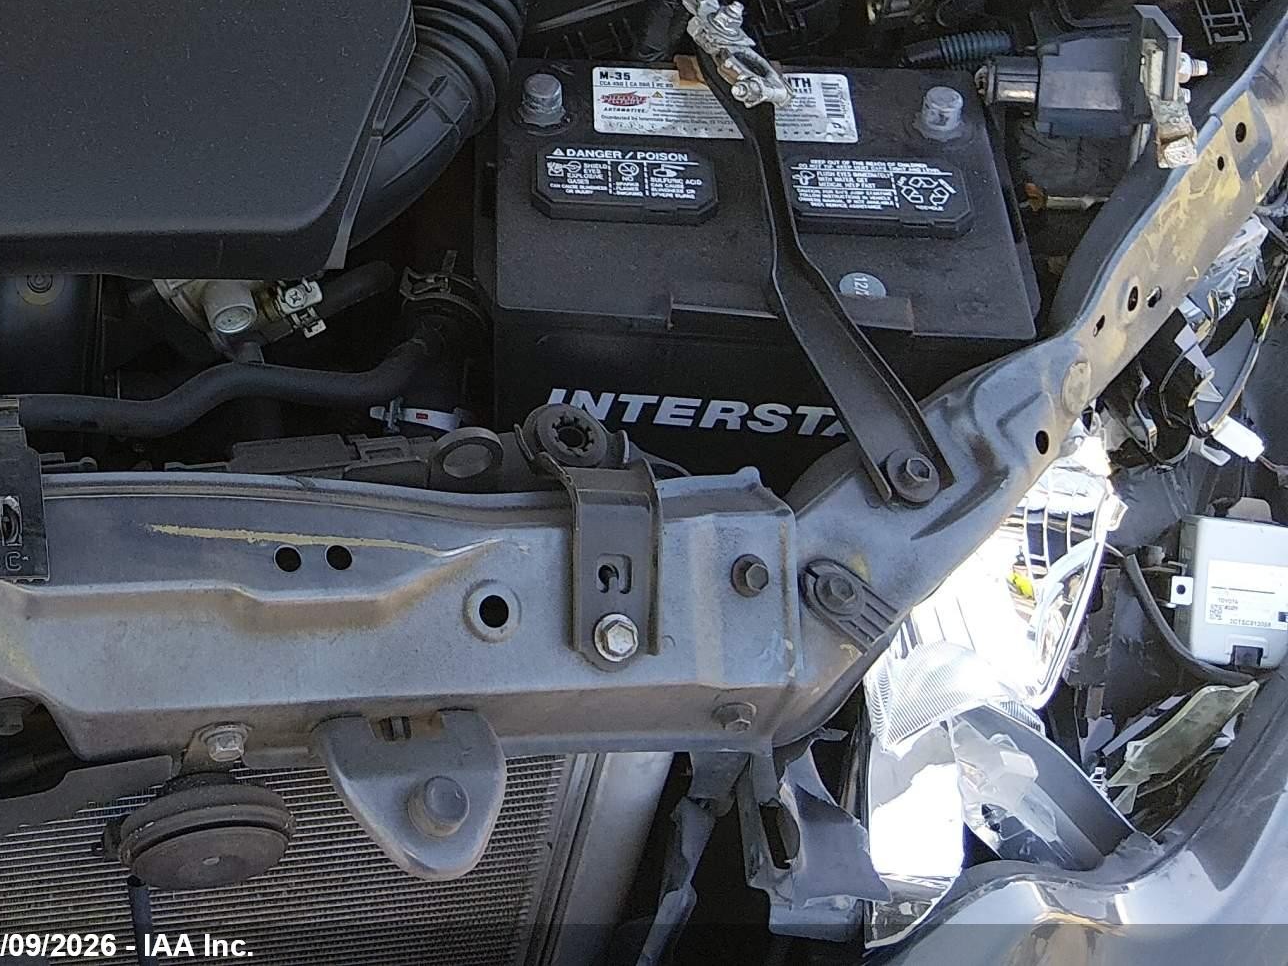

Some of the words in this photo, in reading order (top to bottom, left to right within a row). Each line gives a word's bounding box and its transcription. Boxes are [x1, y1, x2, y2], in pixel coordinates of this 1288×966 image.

[599, 71, 631, 80] M-35
[566, 149, 622, 159] DANGER
[637, 152, 688, 161] POISON
